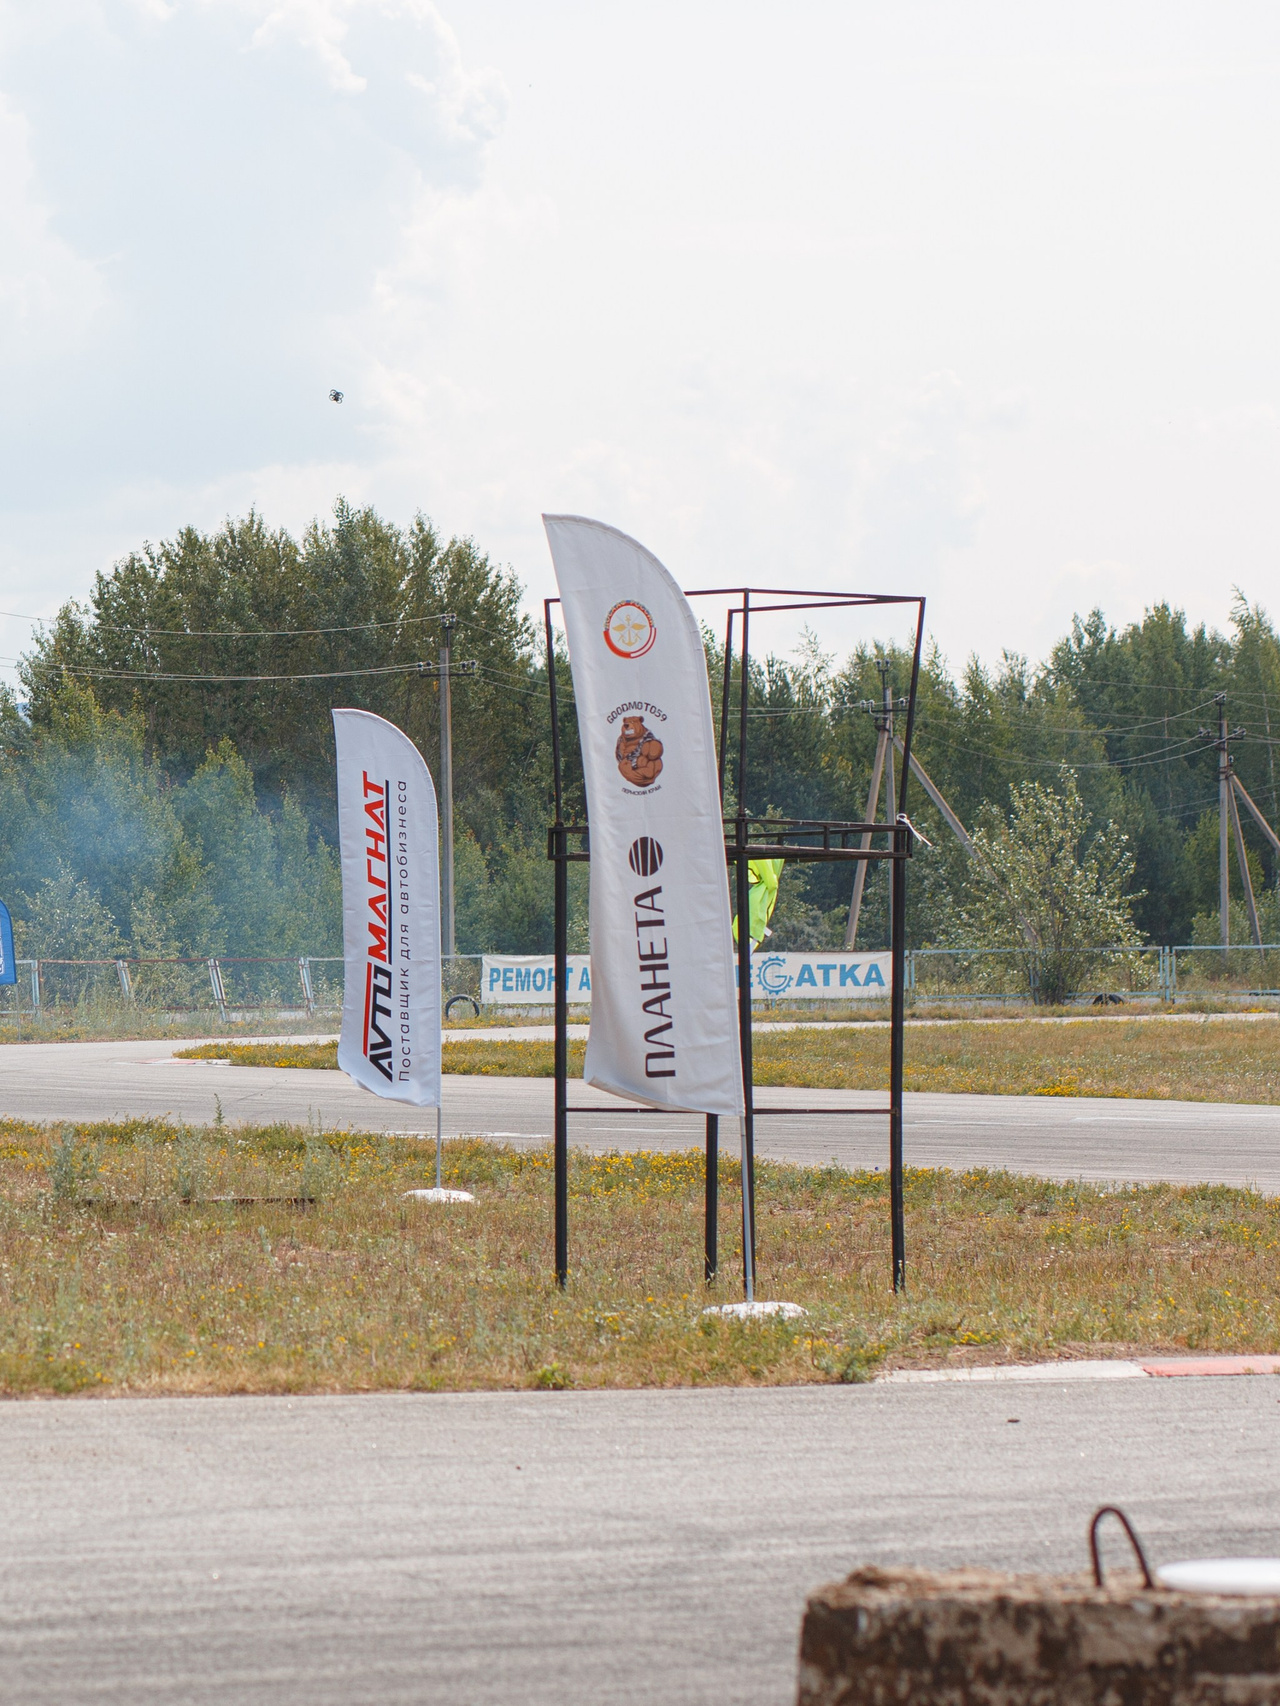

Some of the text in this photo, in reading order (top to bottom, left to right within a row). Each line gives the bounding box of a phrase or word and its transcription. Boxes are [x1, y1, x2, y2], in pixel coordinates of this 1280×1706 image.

[607, 701, 668, 724] GOODMOTO59
[396, 780, 411, 1081] Поставщик для автобизнеса
[634, 886, 676, 1078] ПЛАНЕТА
